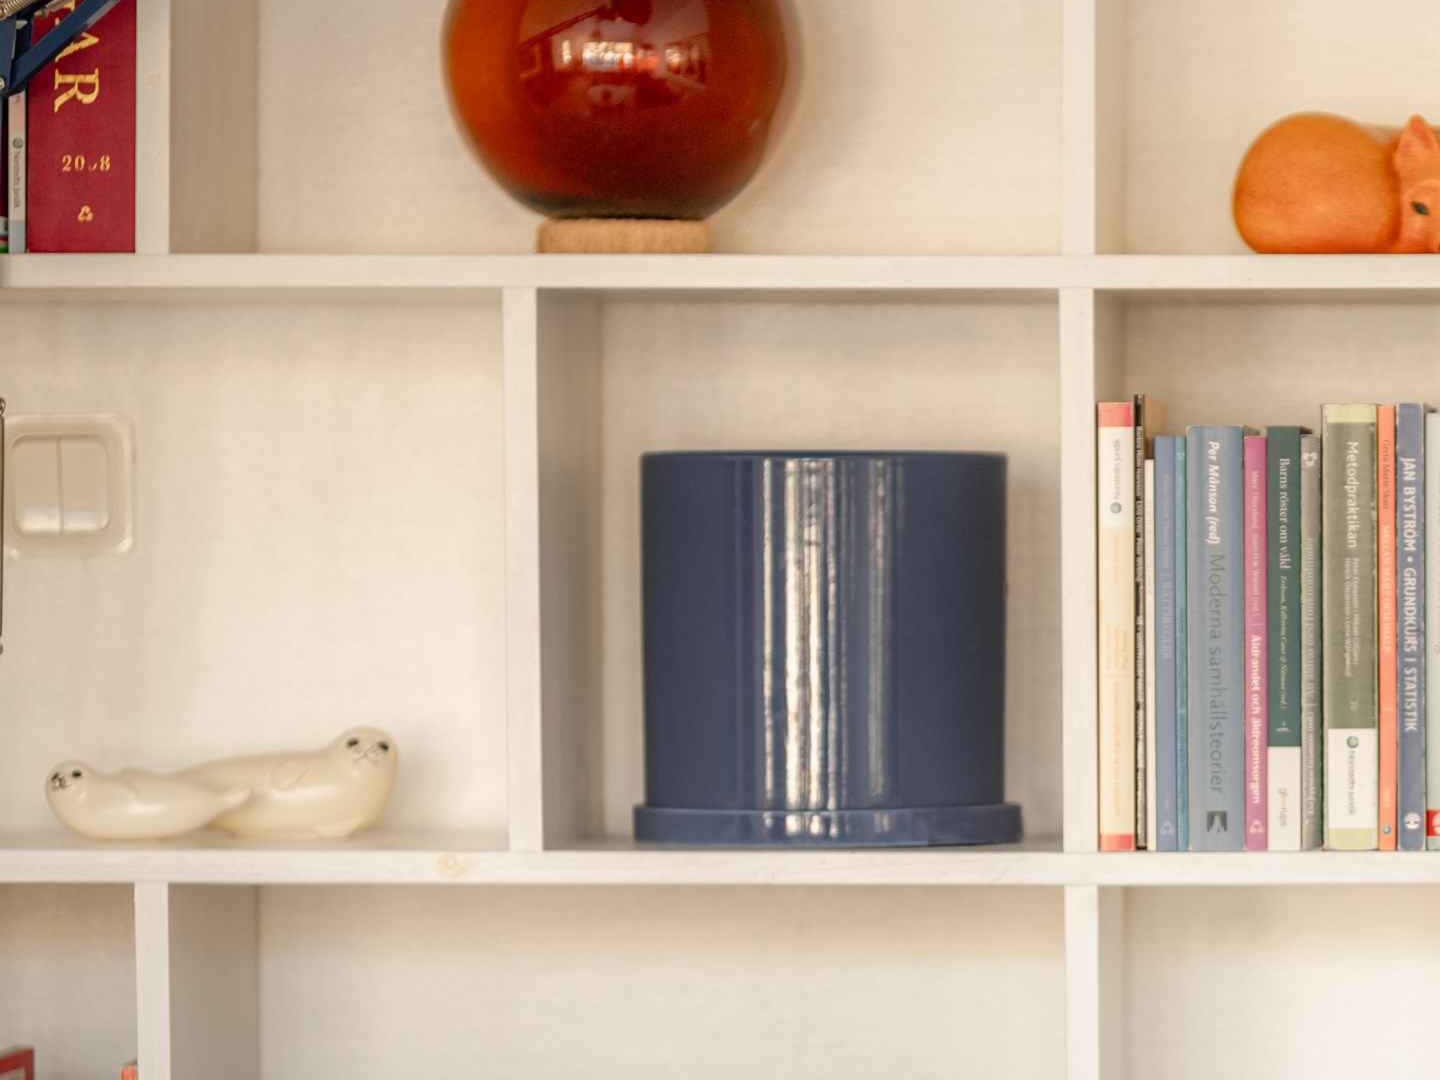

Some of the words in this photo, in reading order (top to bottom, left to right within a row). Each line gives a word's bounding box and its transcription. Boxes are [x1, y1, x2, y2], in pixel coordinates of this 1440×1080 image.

[1207, 440, 1220, 461] Per
[1278, 458, 1291, 487] Barns
[1401, 457, 1416, 481] JAN
[1207, 464, 1222, 513] Månson
[1343, 441, 1360, 548] Metodpraktikan
[1278, 491, 1291, 523] röster
[1402, 486, 1421, 551] BYSTRÖM
[1205, 516, 1221, 544] (red)
[1279, 526, 1289, 543] om
[1278, 545, 1292, 569] våld
[1208, 554, 1225, 639] Moderna
[1402, 567, 1418, 652] GRUNDKURS
[1251, 693, 1263, 714] och
[1403, 667, 1419, 732] STATISTIK
[1208, 646, 1227, 793] samhällsteorier
